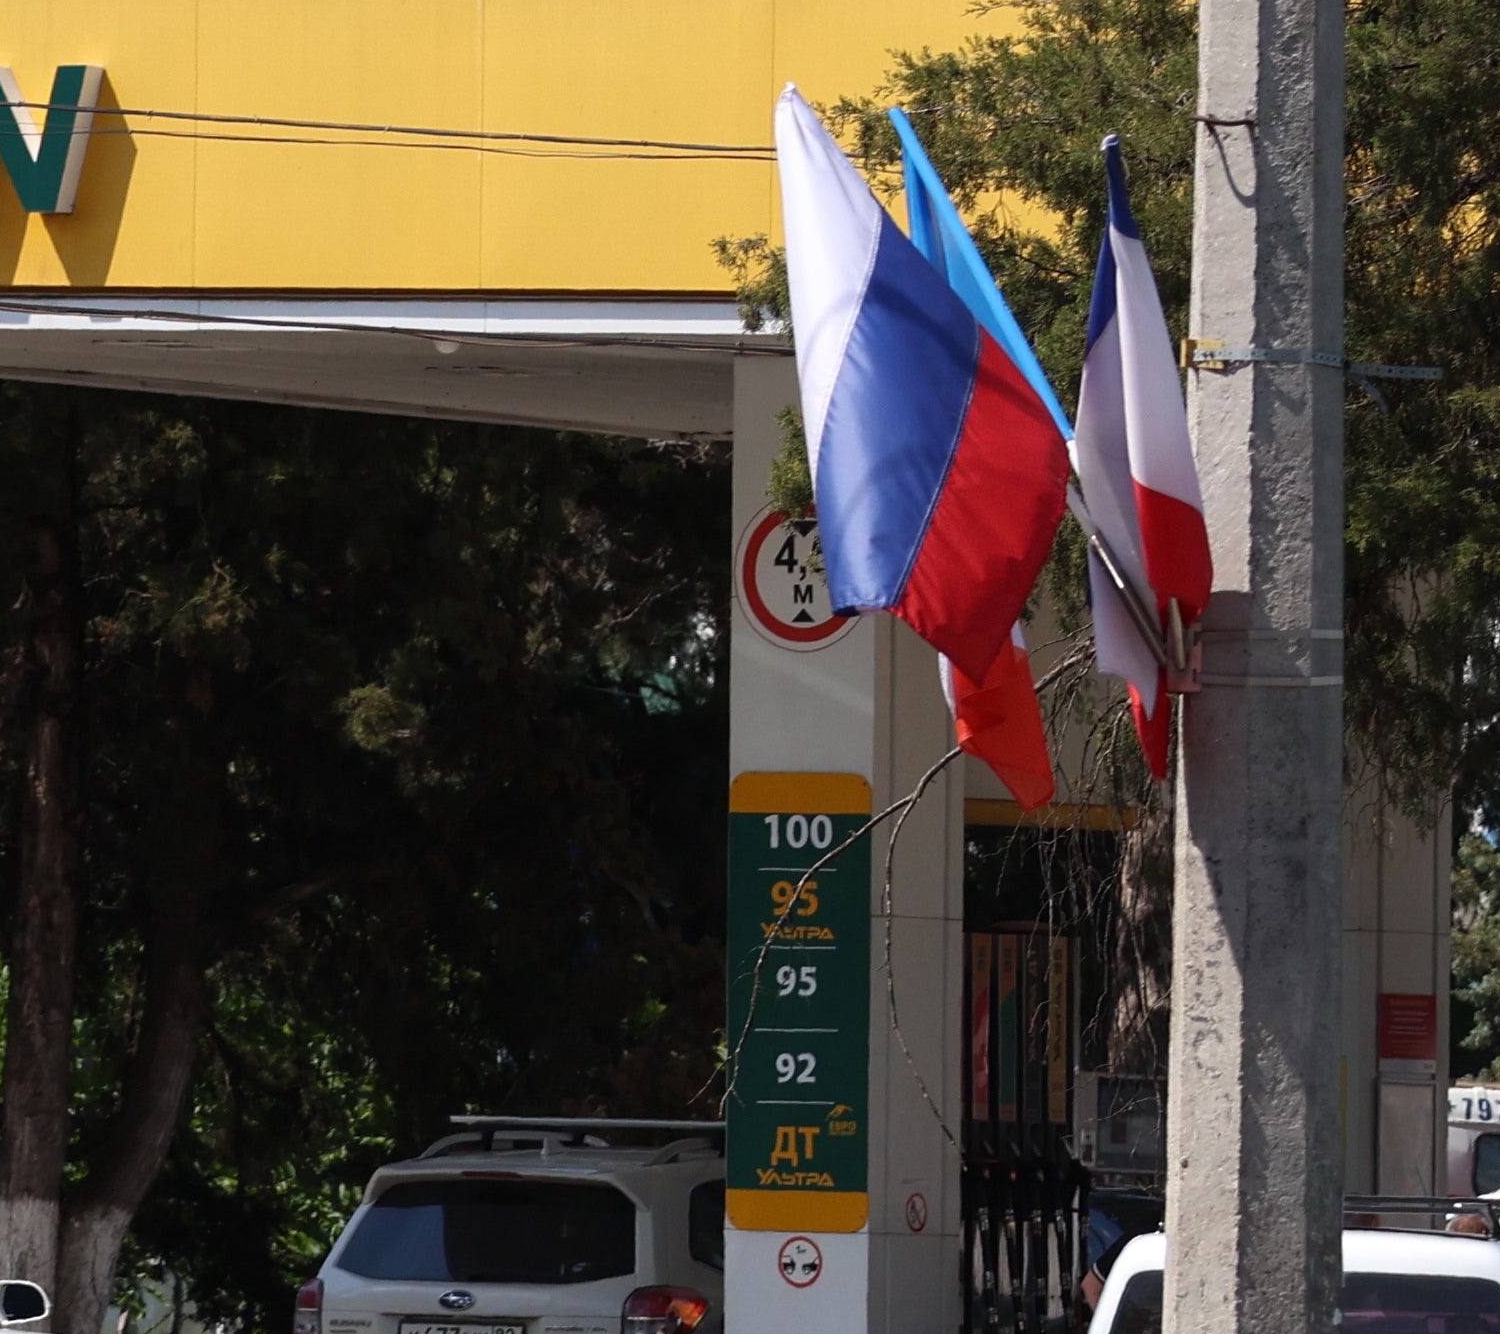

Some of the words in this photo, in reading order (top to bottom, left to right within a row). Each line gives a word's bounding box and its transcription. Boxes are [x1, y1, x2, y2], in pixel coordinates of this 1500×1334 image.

[764, 814, 833, 849] 100
[771, 880, 820, 916] 95
[776, 965, 817, 997] 95
[775, 1052, 817, 1084] 92
[771, 1126, 820, 1167] ДТ
